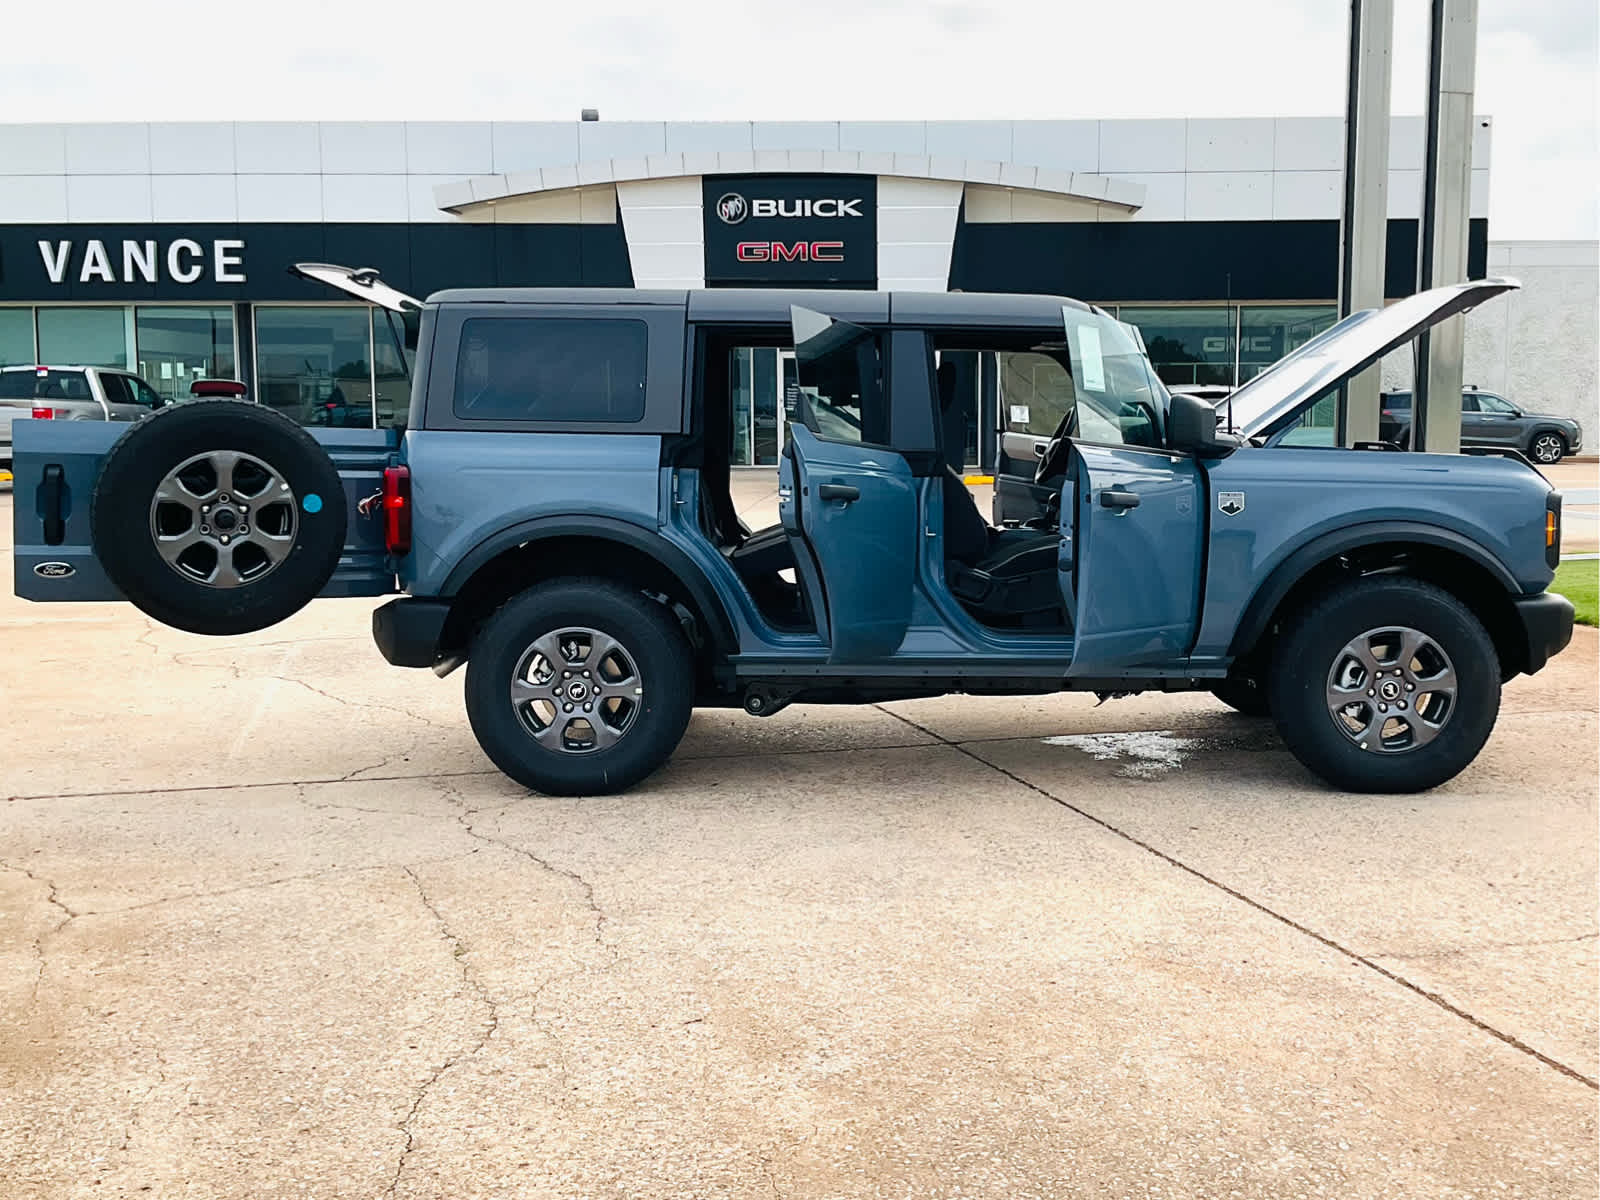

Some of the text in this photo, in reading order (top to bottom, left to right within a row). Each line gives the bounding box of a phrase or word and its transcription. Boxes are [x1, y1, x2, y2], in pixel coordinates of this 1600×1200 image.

[752, 199, 863, 217] BUICK
[38, 238, 247, 283] VANCE
[736, 241, 844, 262] GMC
[1203, 336, 1272, 352] GMC
